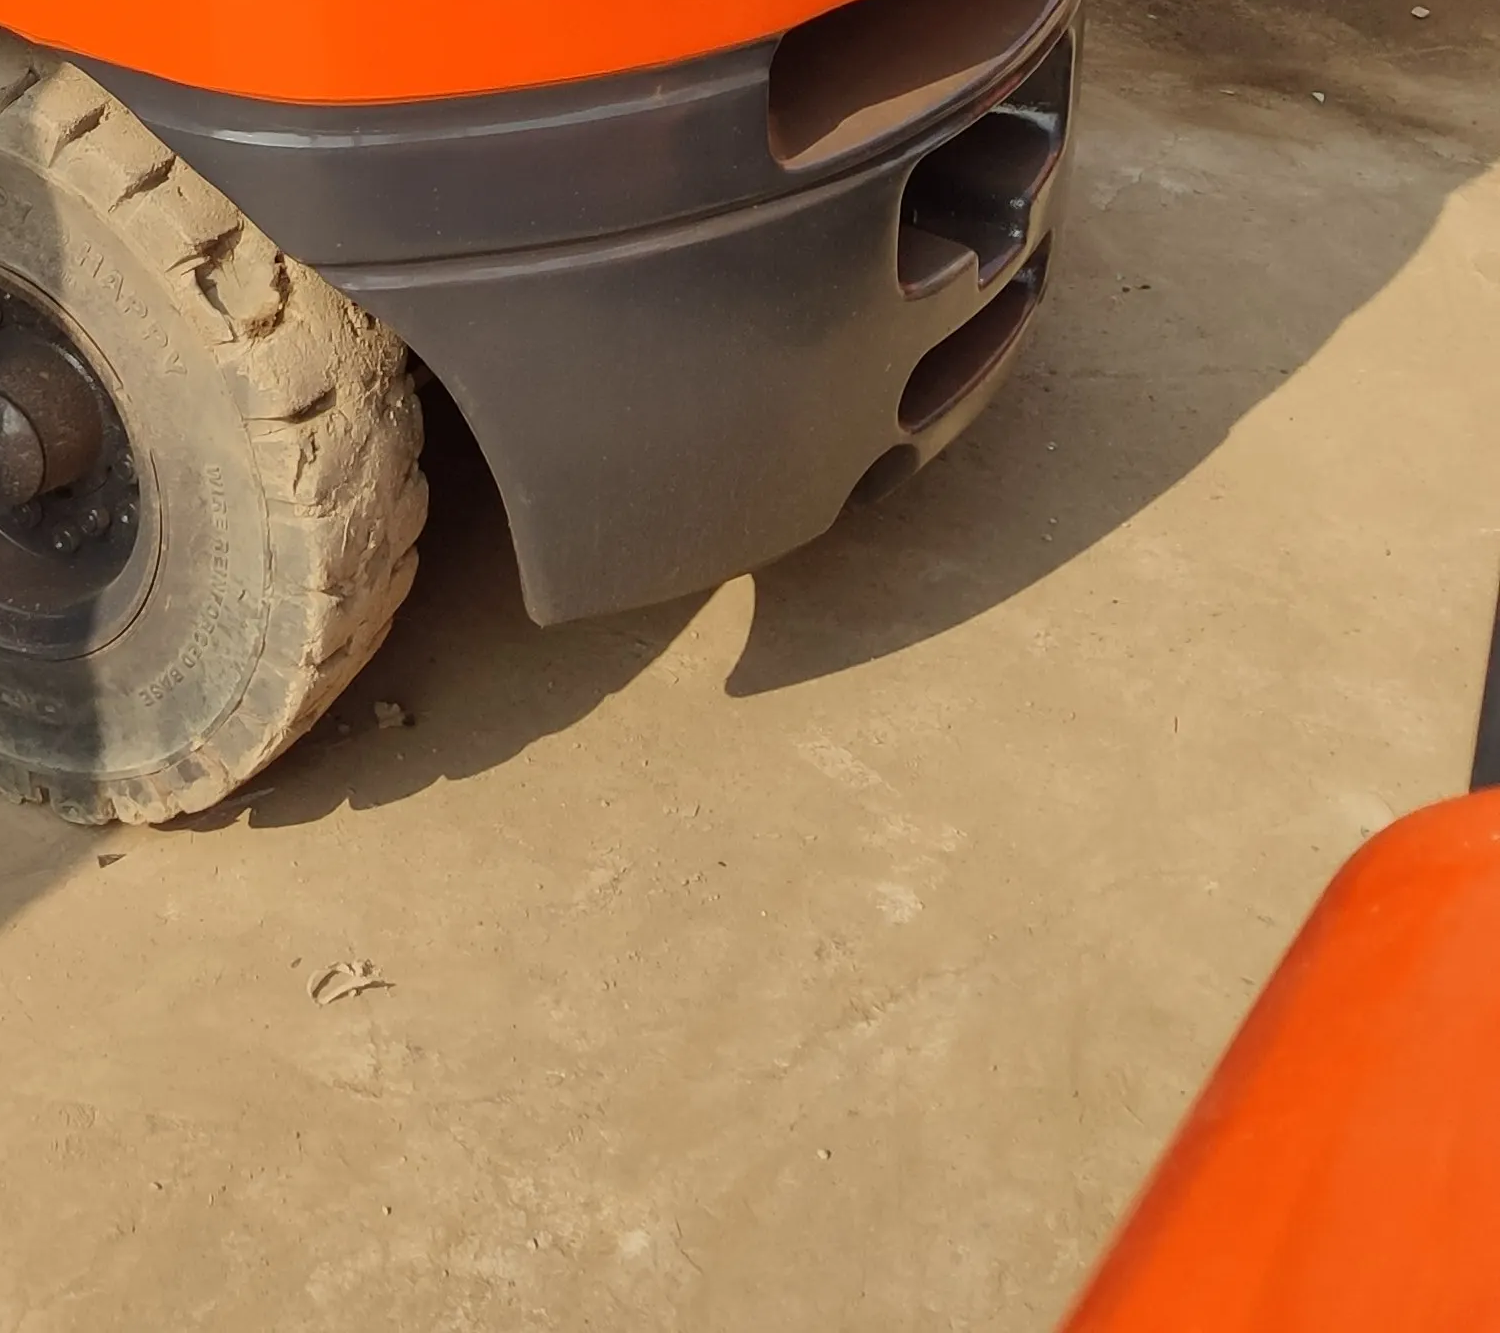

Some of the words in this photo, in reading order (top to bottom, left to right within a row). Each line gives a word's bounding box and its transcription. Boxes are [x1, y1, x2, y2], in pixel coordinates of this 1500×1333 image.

[76, 240, 187, 376] HAPPY
[204, 467, 228, 531] WIRE
[182, 542, 229, 670] REINFORCED
[139, 669, 185, 707] BASE
